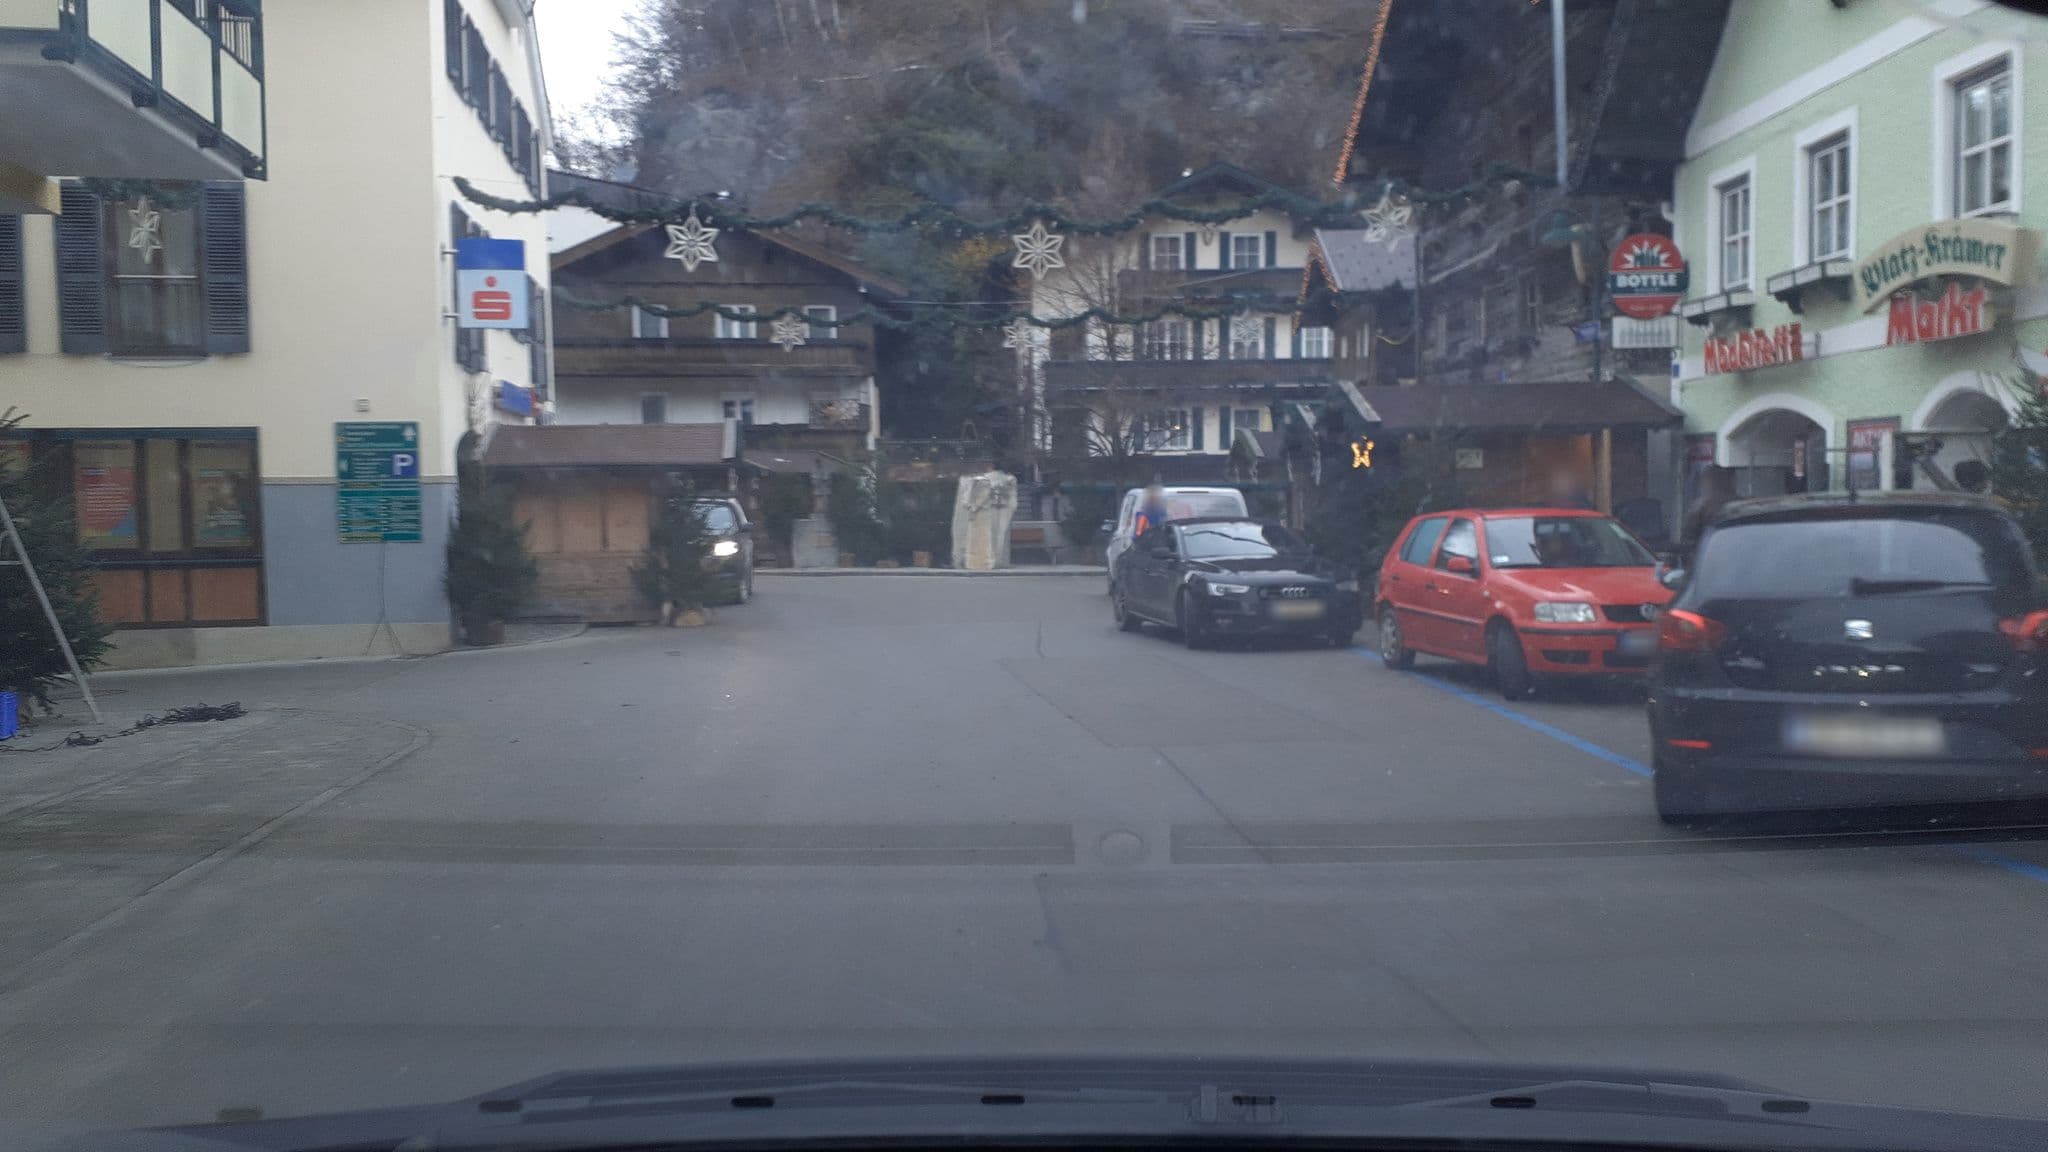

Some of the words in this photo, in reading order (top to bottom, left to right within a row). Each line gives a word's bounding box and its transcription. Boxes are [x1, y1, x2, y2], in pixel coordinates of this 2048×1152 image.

[1616, 274, 1678, 288] BOTTLE
[1887, 281, 1986, 345] Markt
[392, 453, 415, 475] P
